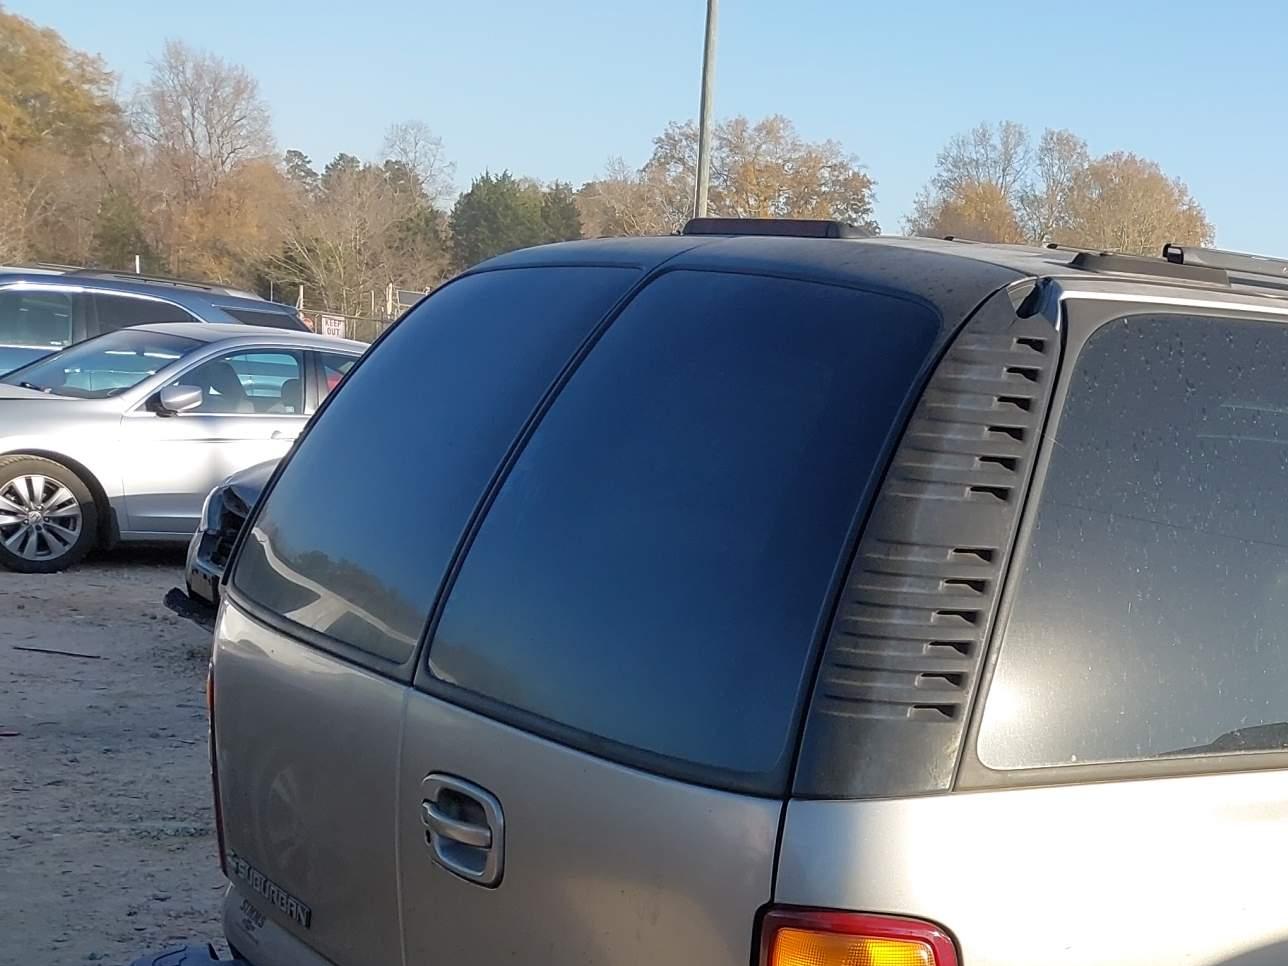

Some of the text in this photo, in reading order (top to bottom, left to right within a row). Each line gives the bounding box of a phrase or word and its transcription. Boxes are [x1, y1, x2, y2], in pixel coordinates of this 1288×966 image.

[325, 319, 342, 328] KEEP
[326, 328, 341, 336] OUT
[238, 856, 312, 929] SUBURBAN
